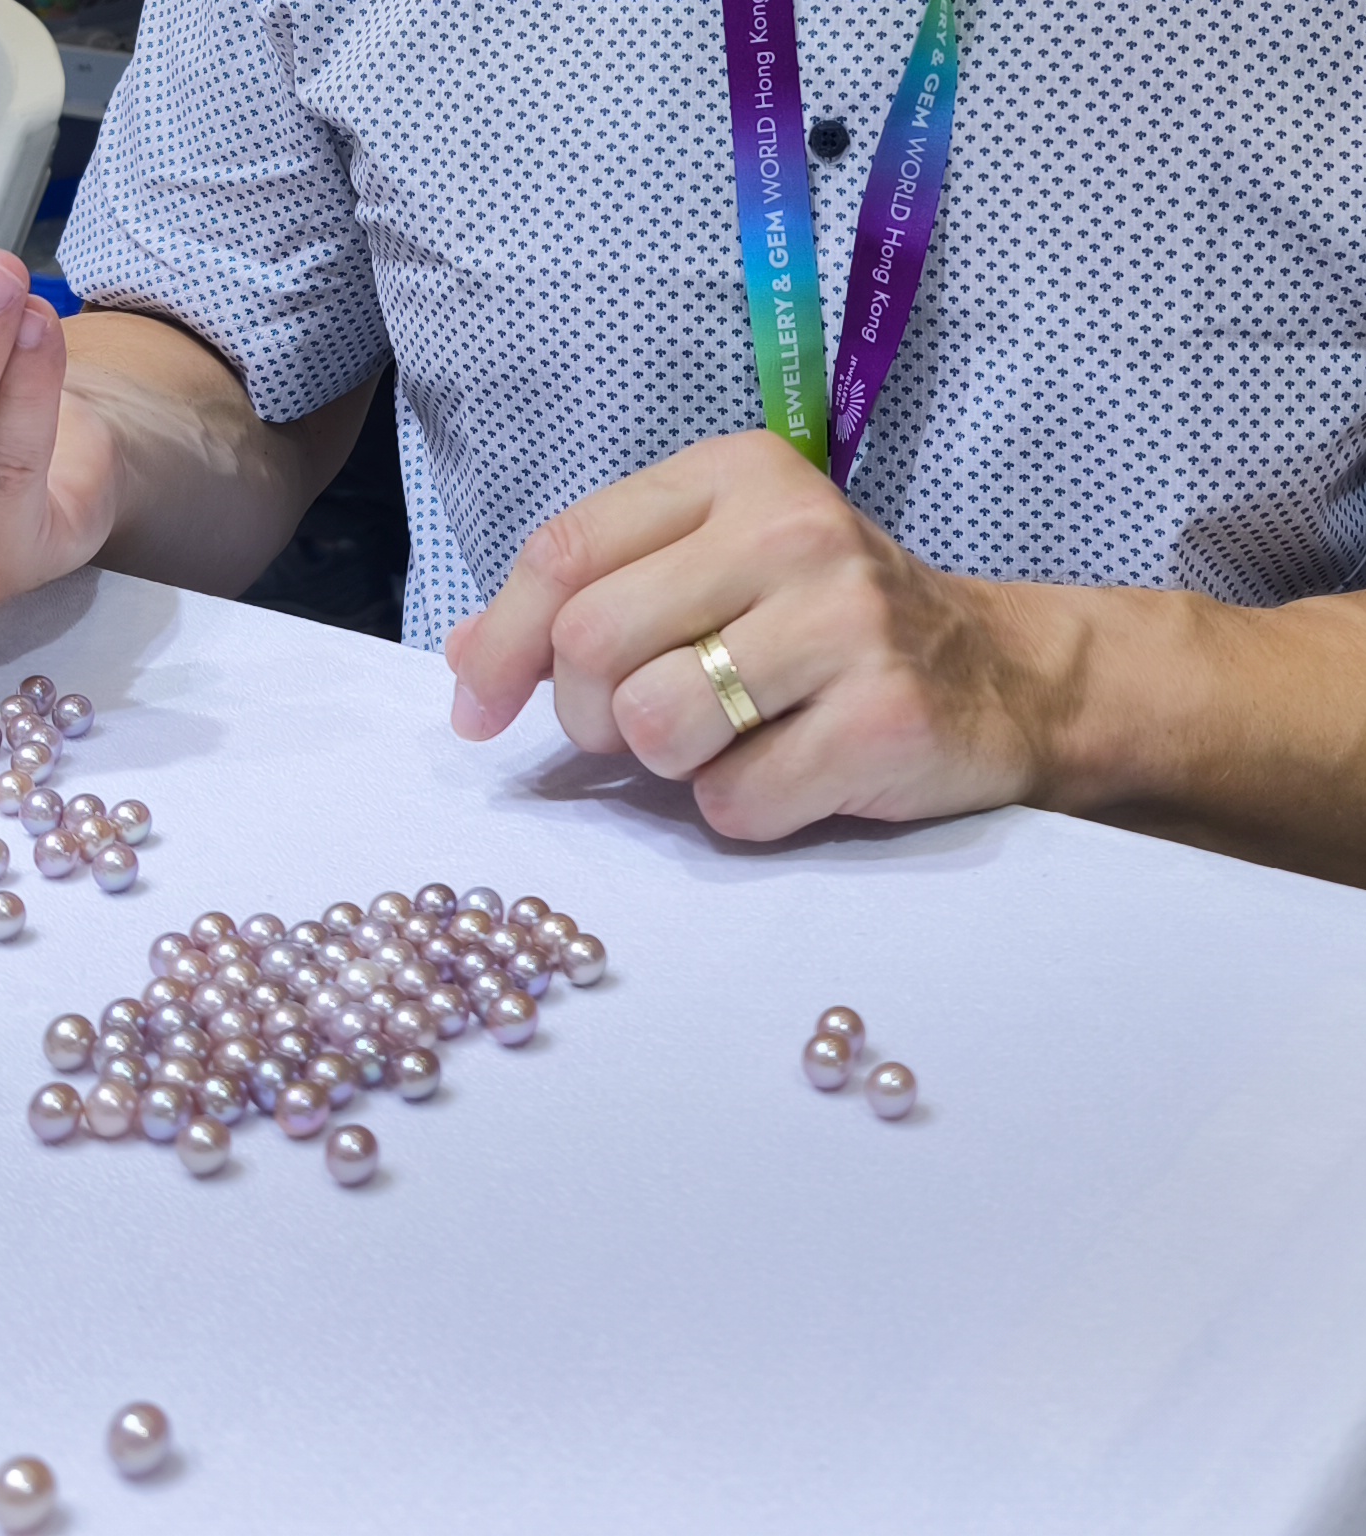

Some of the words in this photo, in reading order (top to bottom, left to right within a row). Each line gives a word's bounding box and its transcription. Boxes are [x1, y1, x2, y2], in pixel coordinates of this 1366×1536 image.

[754, 51, 776, 109] Hong
[930, 48, 945, 67] &
[911, 73, 940, 129] GEM
[757, 116, 783, 204] WORLD
[890, 137, 927, 222] WORLD
[765, 210, 789, 269] GEM
[872, 227, 906, 285] Hong
[771, 273, 792, 292] &
[861, 289, 892, 344] Kong
[774, 297, 812, 440] JEWELLERY
